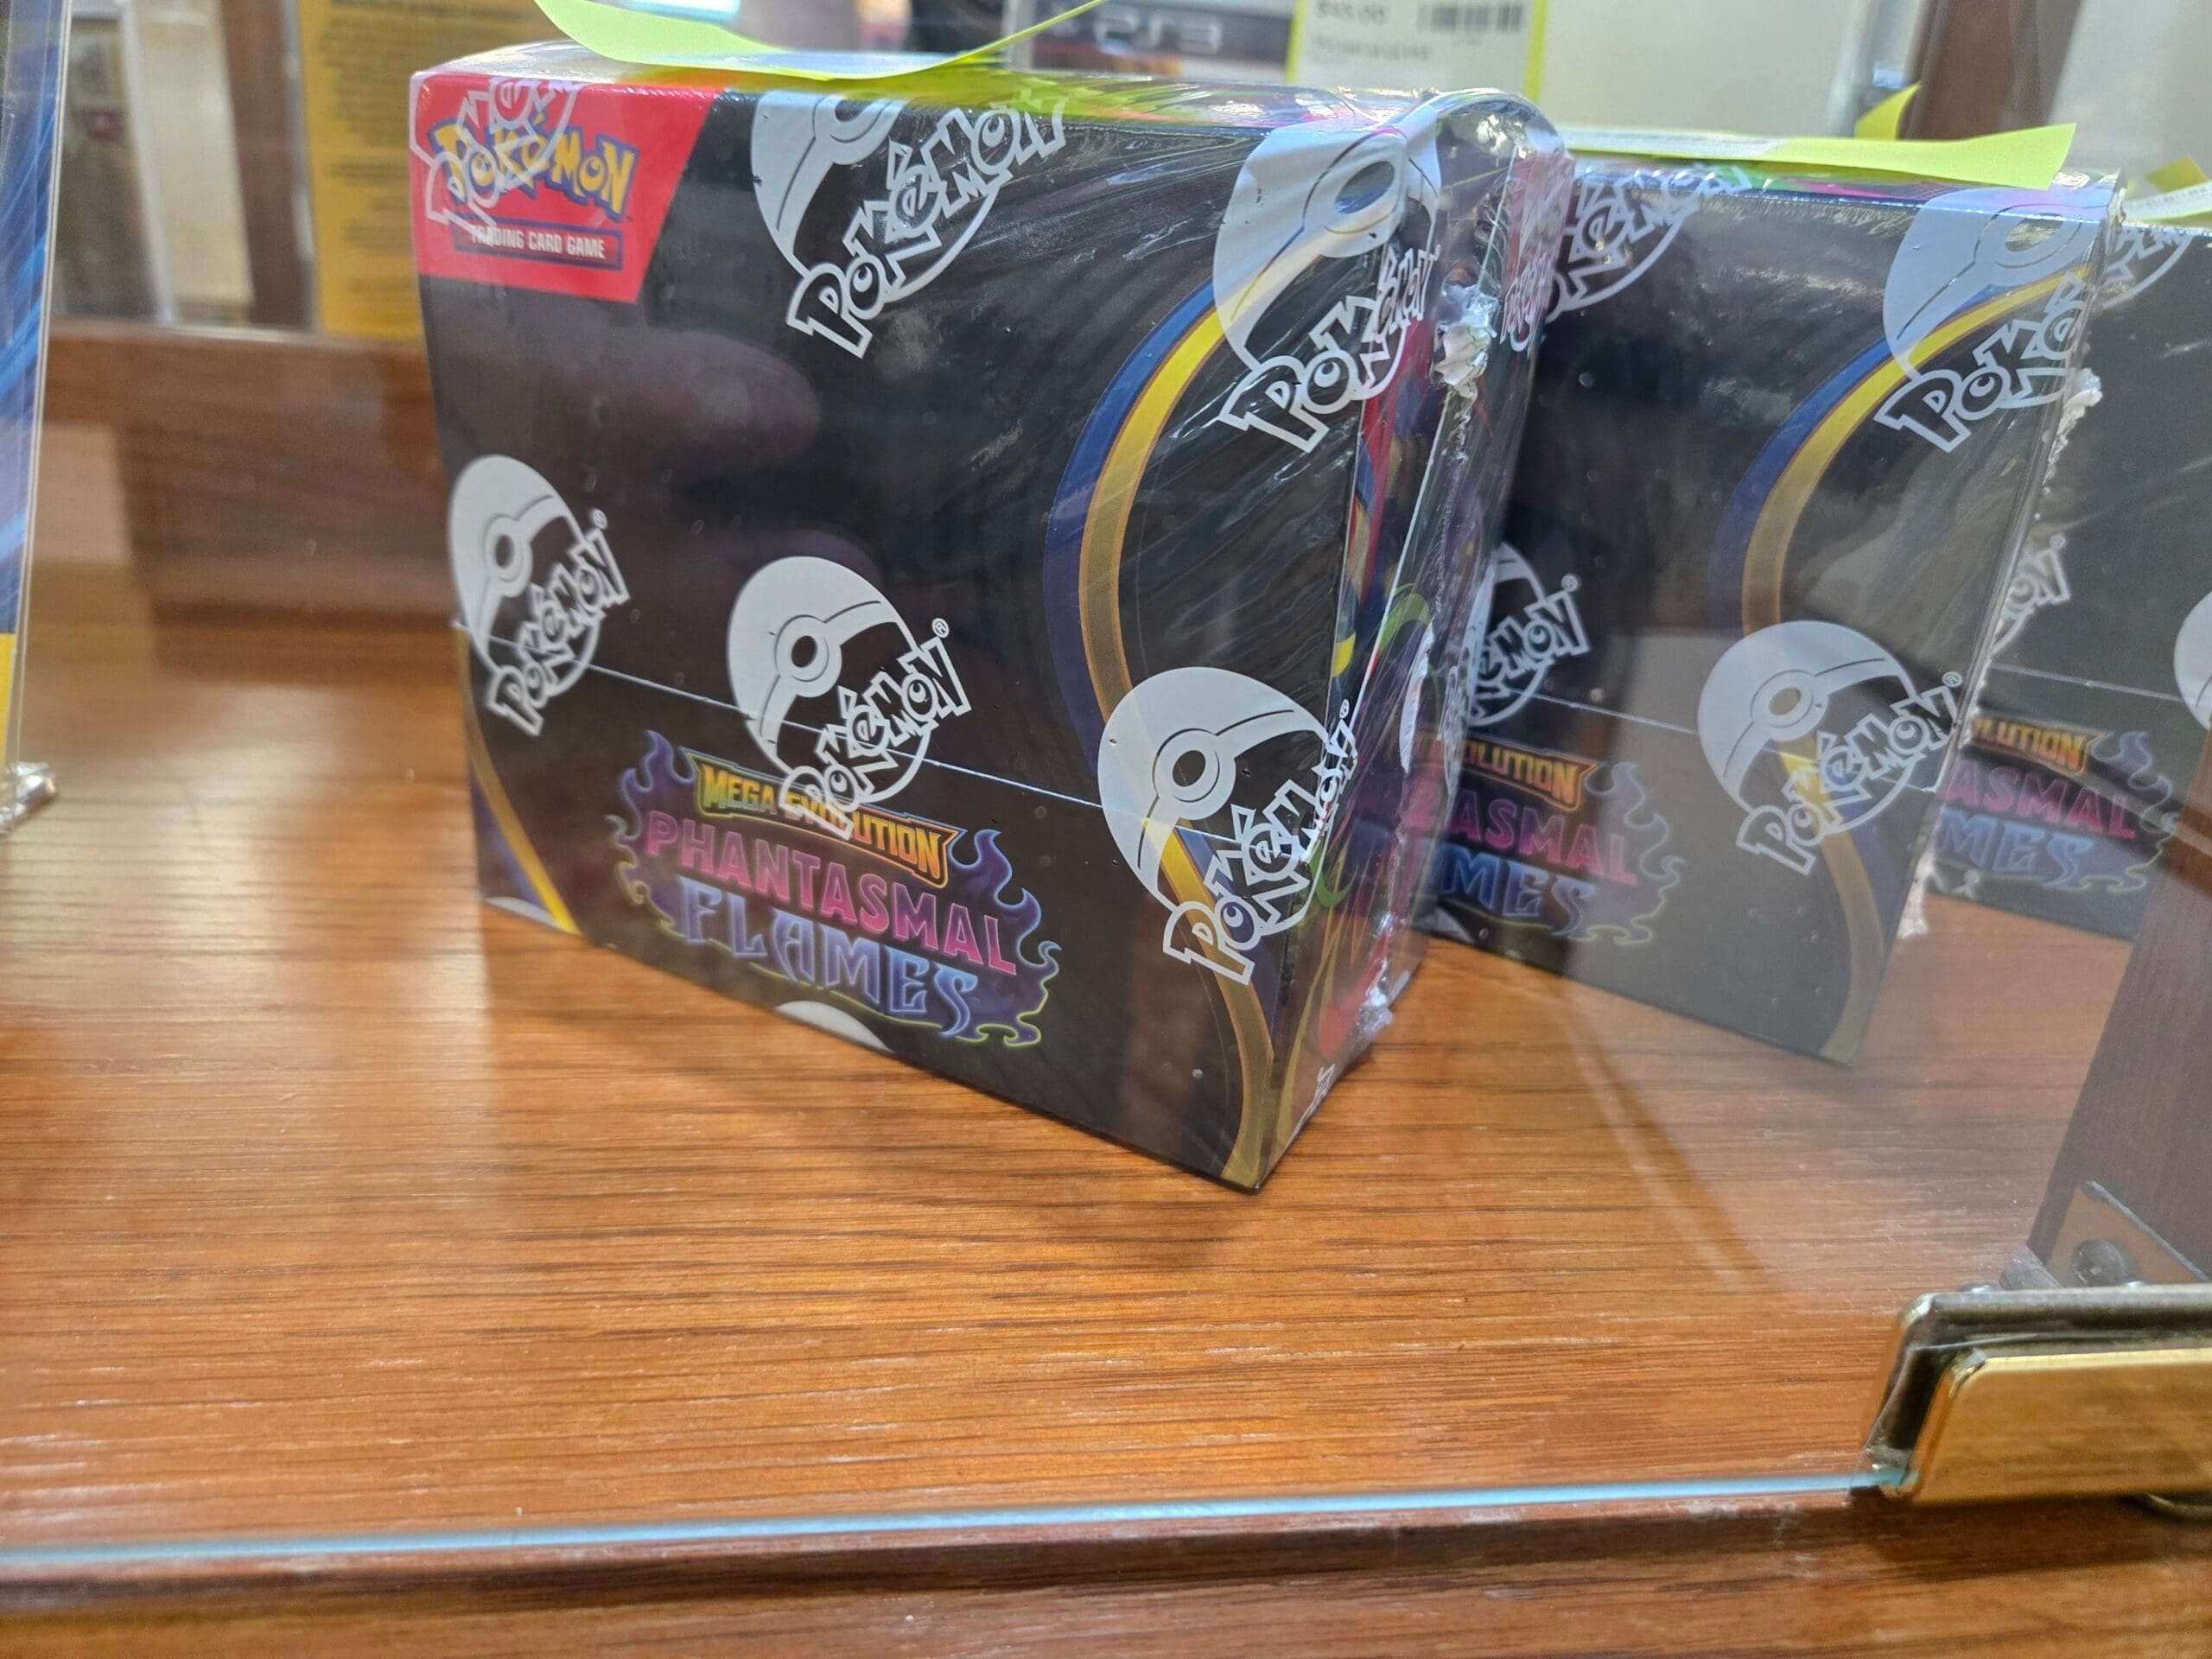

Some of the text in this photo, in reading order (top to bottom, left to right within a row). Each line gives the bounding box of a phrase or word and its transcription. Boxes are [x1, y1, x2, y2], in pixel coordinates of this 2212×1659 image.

[473, 224, 606, 259] TRADING CARD GAME
[701, 762, 778, 816] MEGA
[645, 809, 1017, 976] PHANTASMAL
[676, 875, 978, 1037] FLAMES
